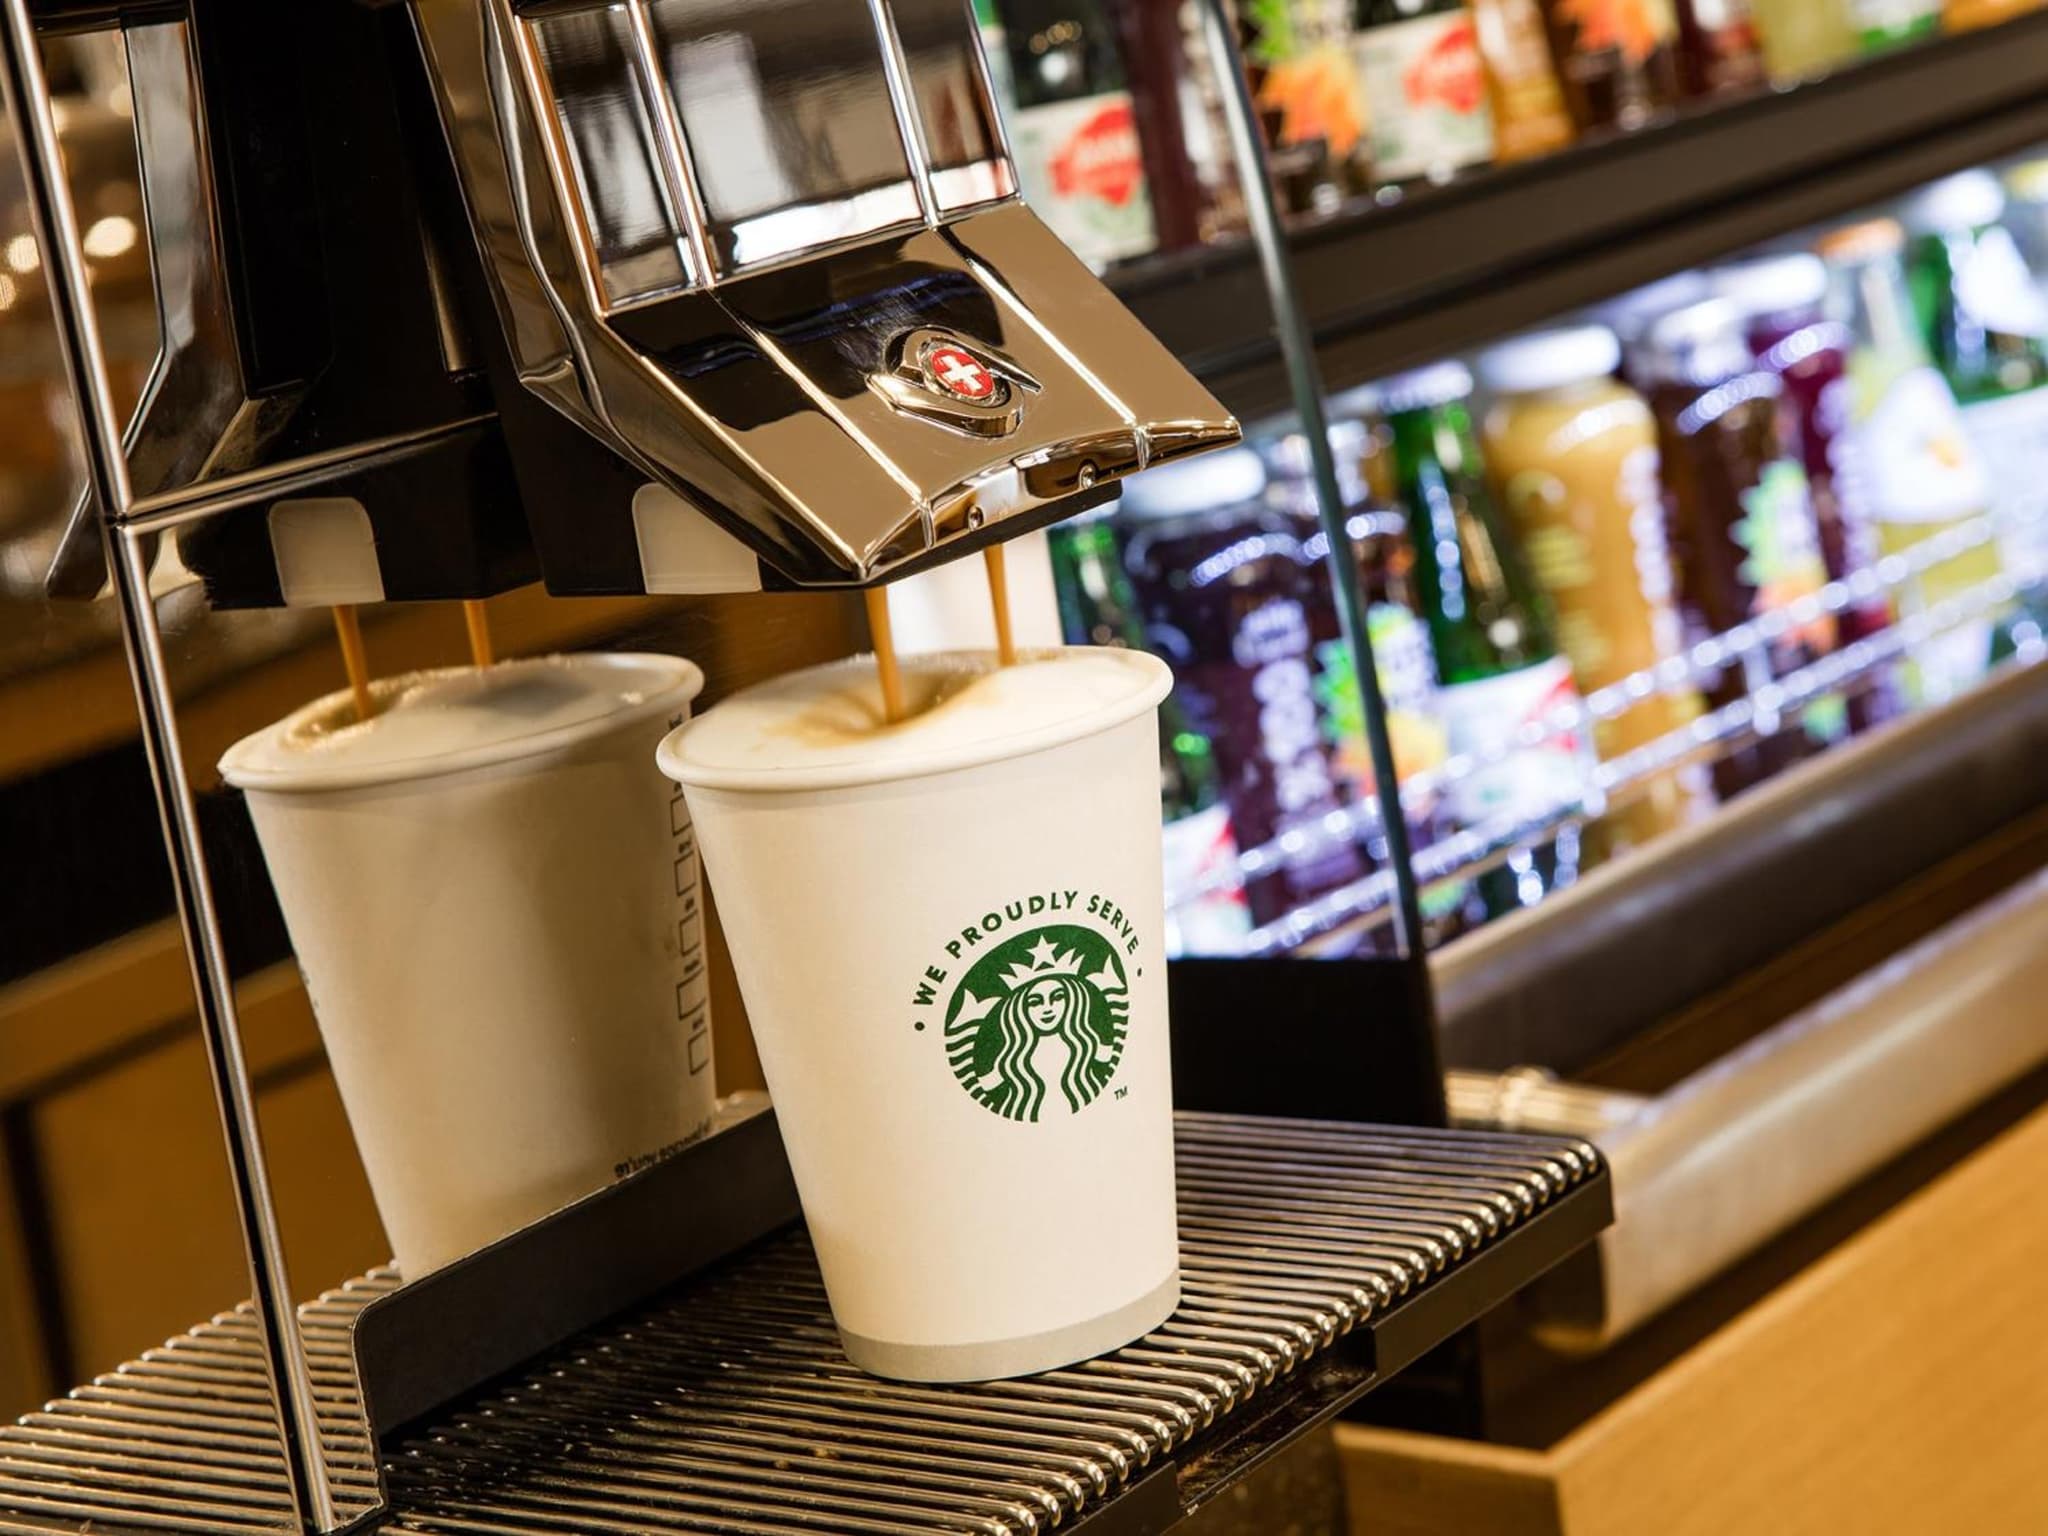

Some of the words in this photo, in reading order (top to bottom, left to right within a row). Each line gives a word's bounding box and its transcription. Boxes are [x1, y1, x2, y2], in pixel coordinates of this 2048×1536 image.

[912, 965, 948, 1006] WE
[944, 890, 1078, 960] PROUDLY
[1086, 894, 1139, 955] SERVE
[1114, 1086, 1128, 1100] TM
